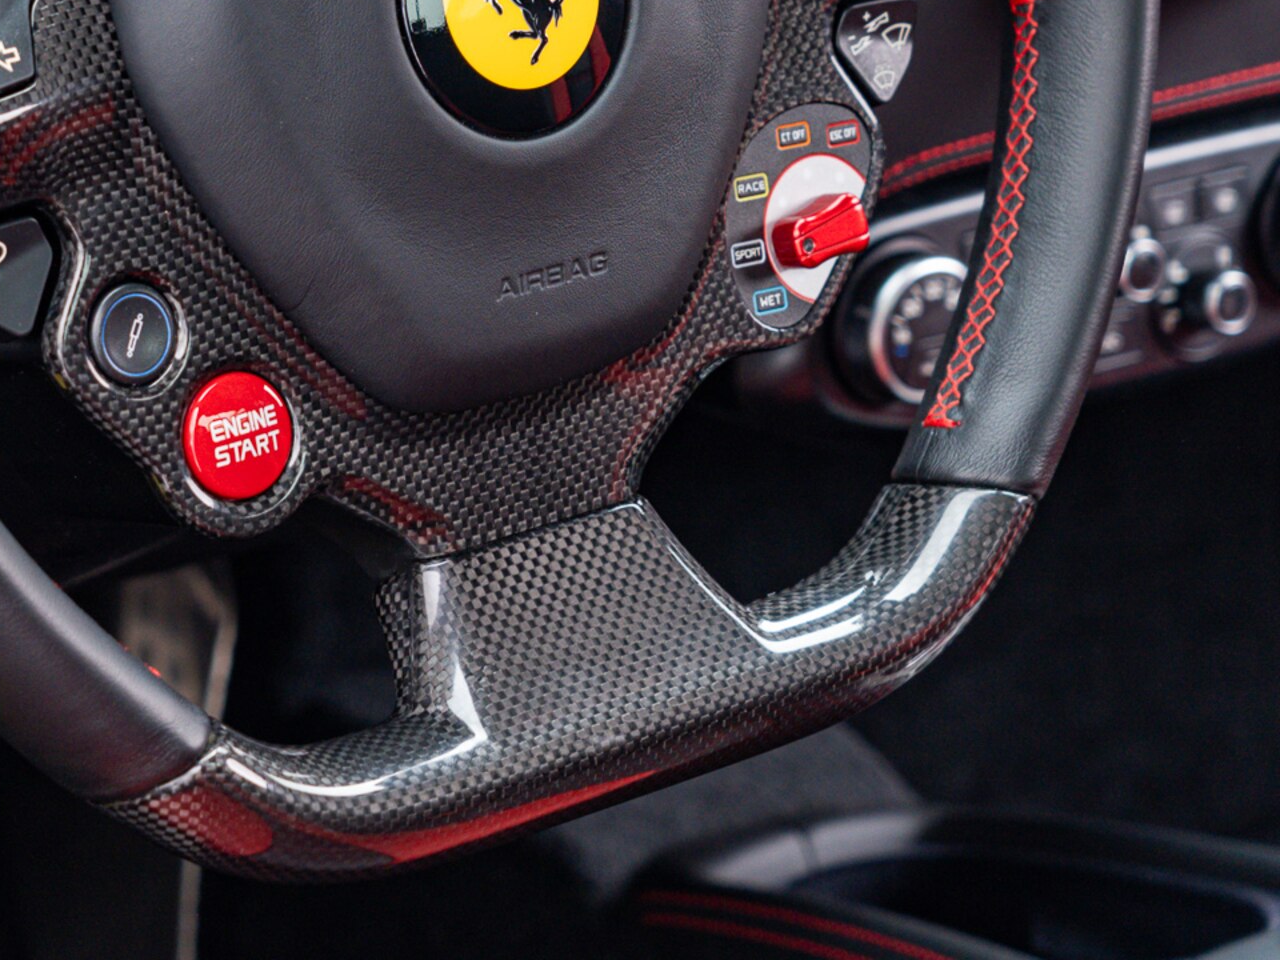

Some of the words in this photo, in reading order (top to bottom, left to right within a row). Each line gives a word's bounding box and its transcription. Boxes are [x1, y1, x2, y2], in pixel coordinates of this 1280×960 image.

[780, 131, 792, 144] CT
[792, 128, 807, 142] OFF
[830, 128, 844, 142] ESC
[844, 126, 857, 140] OFF
[737, 179, 766, 194] RACE
[734, 246, 763, 262] SPORT
[496, 250, 609, 303] AIRBAG
[759, 292, 782, 309] WET
[209, 404, 278, 443] ENGINE
[214, 429, 280, 468] START
